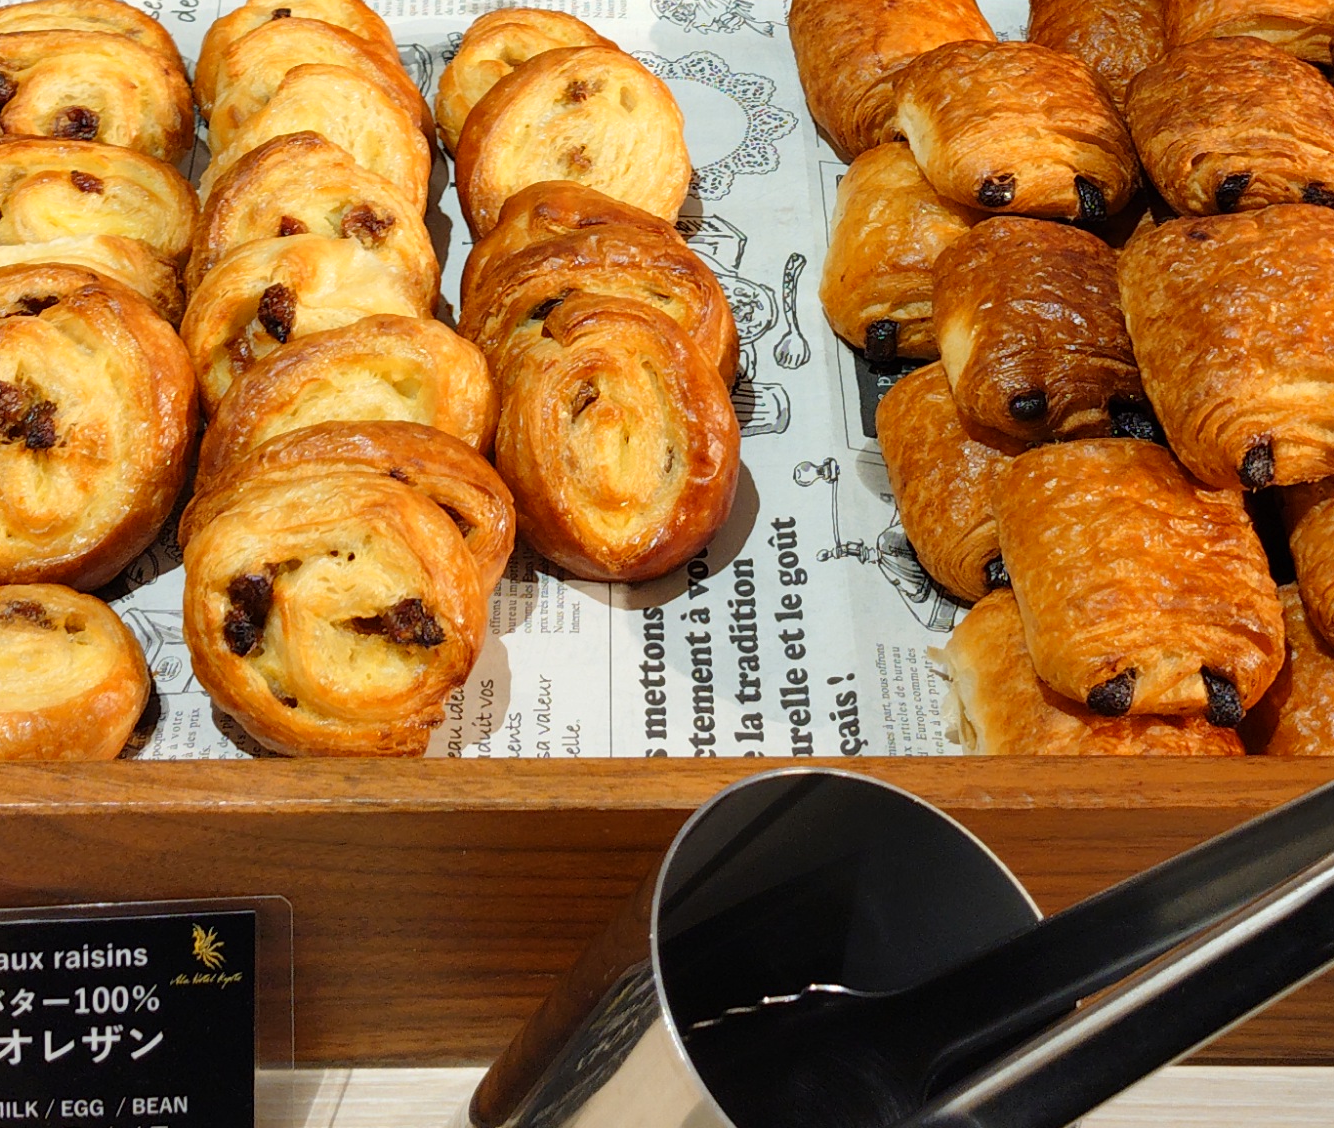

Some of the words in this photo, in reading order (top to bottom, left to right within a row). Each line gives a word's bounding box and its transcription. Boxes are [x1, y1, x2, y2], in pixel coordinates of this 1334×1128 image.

[766, 515, 809, 587] goût
[679, 607, 711, 625] à
[773, 593, 804, 623] le
[726, 557, 763, 705] tradition
[777, 628, 807, 661] et
[874, 642, 888, 677] offrons
[891, 646, 904, 683] bureau
[905, 647, 918, 665] des
[637, 606, 668, 741] mettons
[908, 666, 923, 704] comme
[925, 673, 941, 696] prix
[478, 678, 494, 709] vos
[532, 673, 553, 736] valeur
[894, 685, 907, 699] de
[927, 698, 941, 717] des
[733, 712, 765, 743] la
[778, 667, 815, 758] urelle
[829, 690, 869, 758] çais
[896, 701, 913, 742] articles
[930, 739, 945, 756] cela
[53, 943, 149, 971] raisins
[60, 1098, 105, 1118] EGG
[131, 1095, 189, 1116] BEAN
